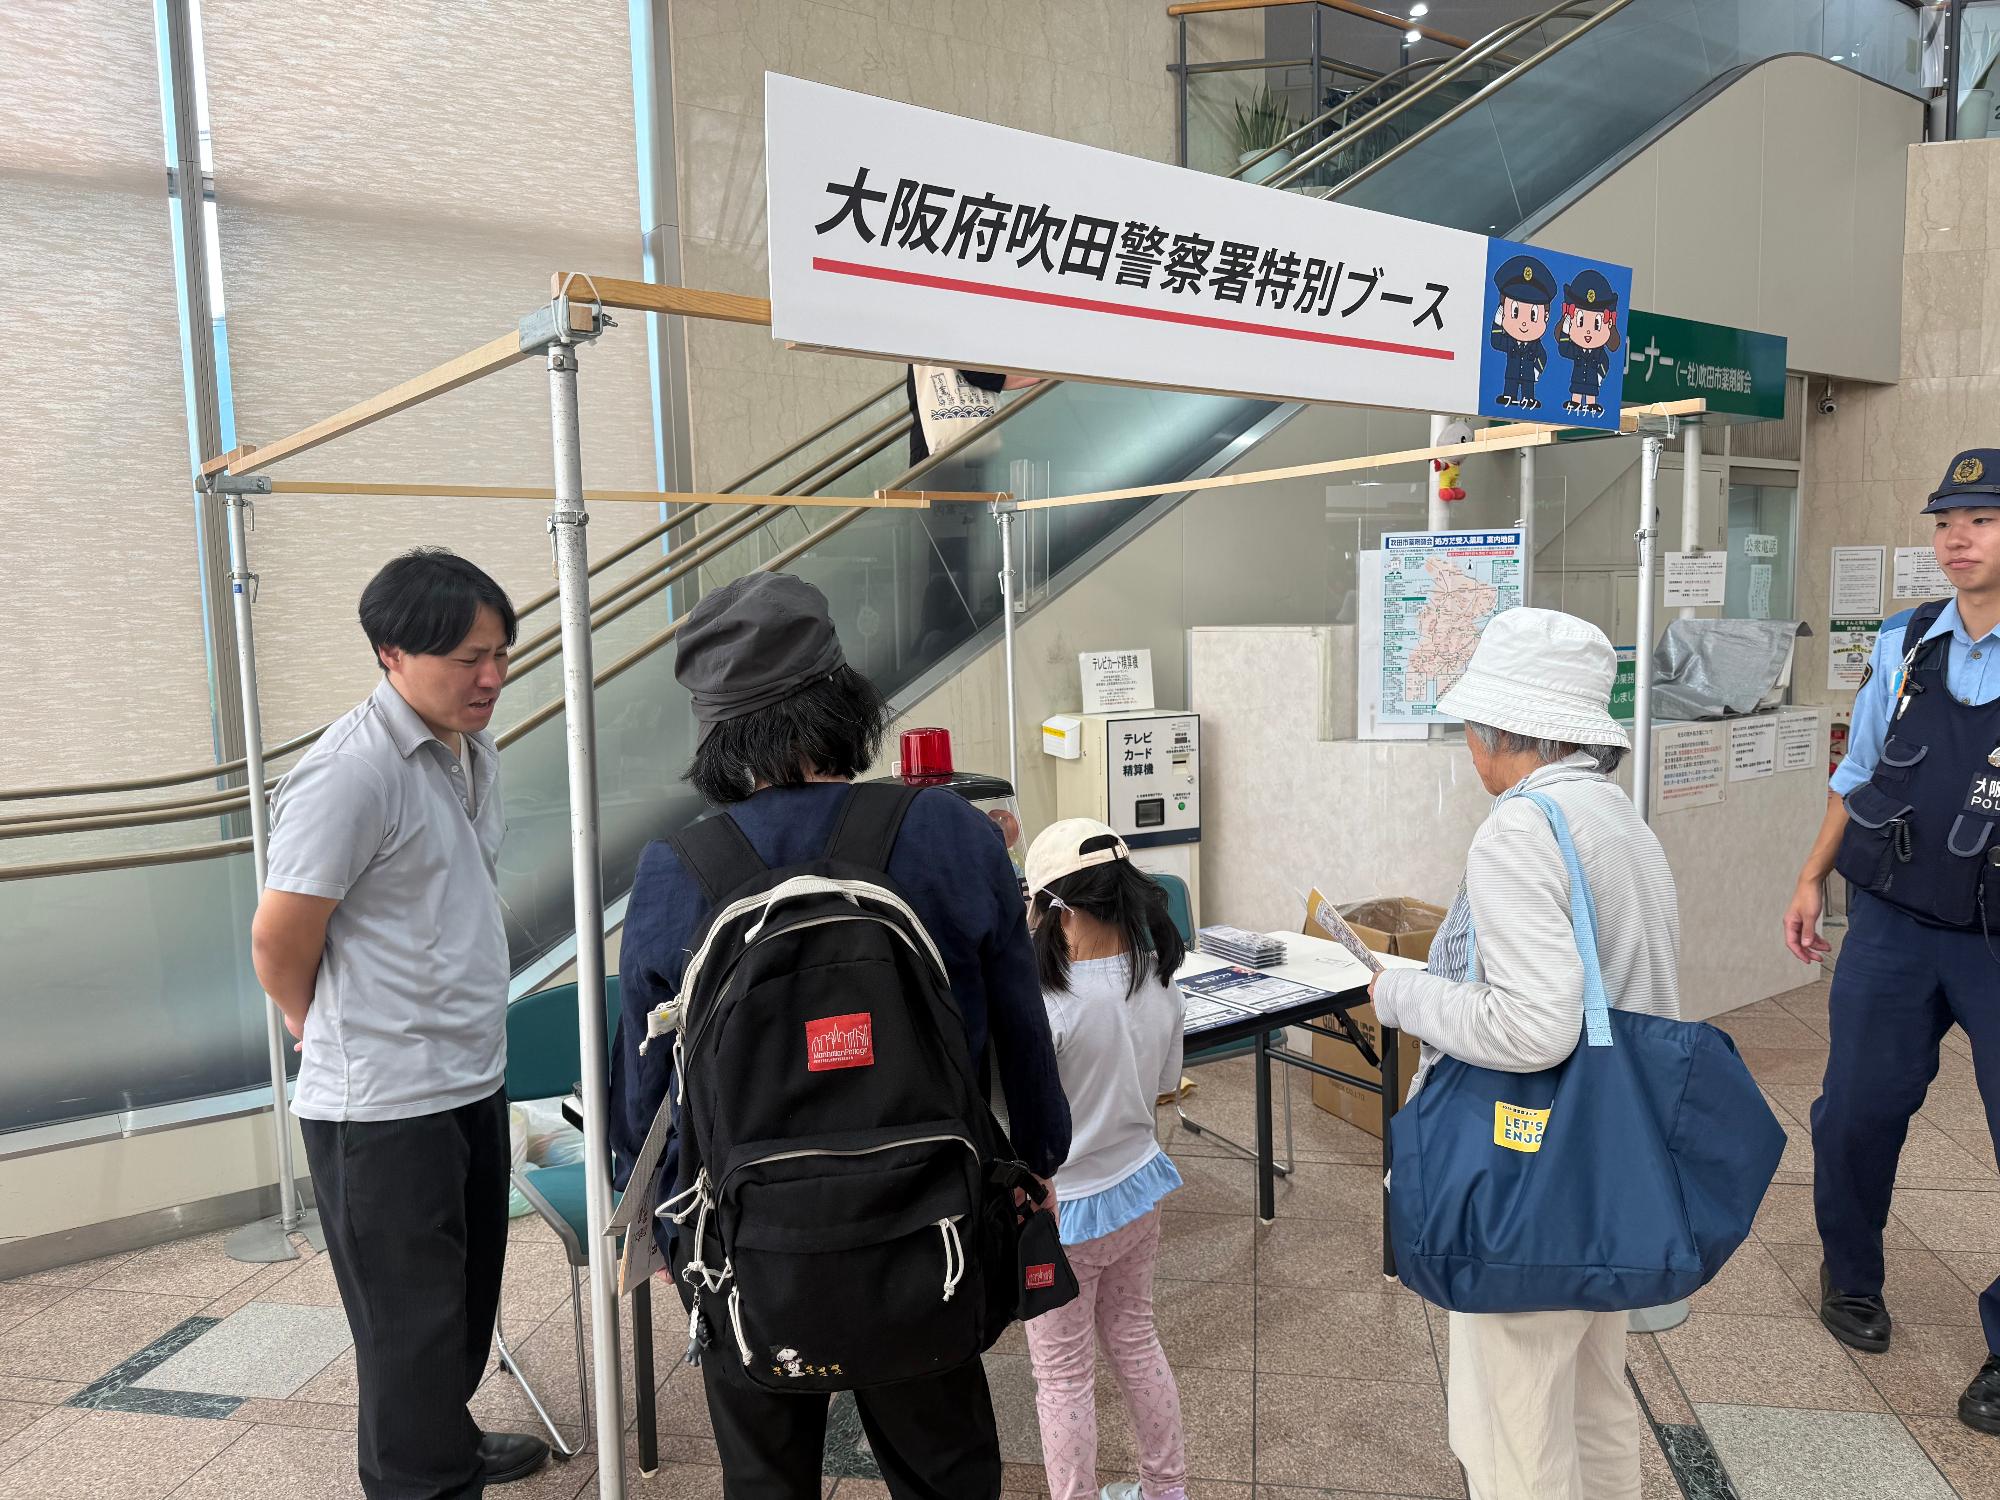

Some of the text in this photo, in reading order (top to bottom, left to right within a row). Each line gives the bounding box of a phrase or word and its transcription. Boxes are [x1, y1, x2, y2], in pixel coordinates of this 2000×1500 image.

[814, 166, 1450, 330] 大阪府吹田警察署特別ブース
[1504, 395, 1538, 410] フークン
[1566, 402, 1605, 418] ケイチャン
[1745, 538, 1777, 553] 公衆電話
[1092, 654, 1139, 670] テレビカード精算機
[1123, 731, 1153, 745] テレビ
[1124, 748, 1152, 761] カード
[1122, 763, 1154, 777] 精算機
[1505, 1115, 1543, 1131] LET'S
